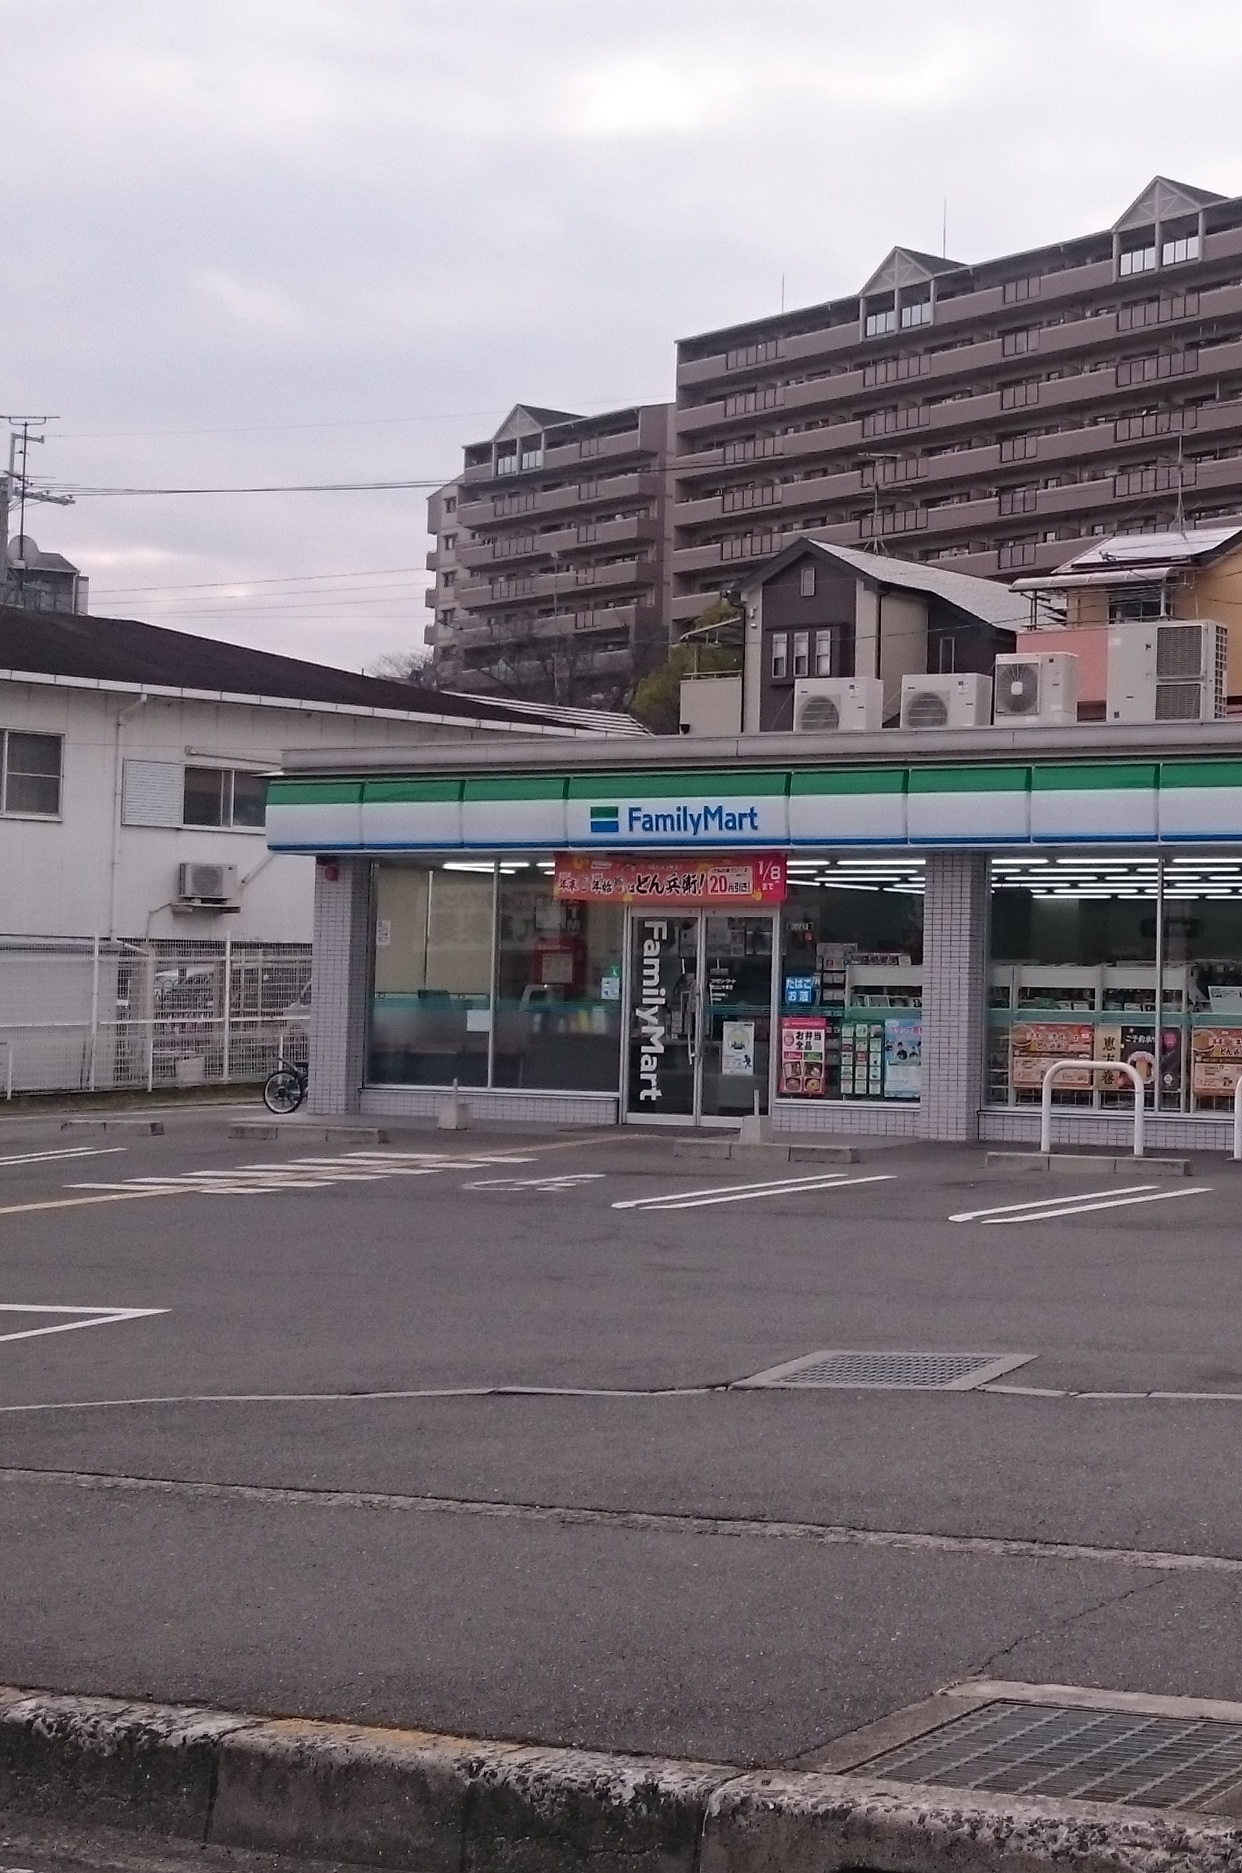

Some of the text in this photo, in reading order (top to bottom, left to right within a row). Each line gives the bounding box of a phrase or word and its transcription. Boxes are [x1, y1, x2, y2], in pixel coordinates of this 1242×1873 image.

[628, 806, 758, 835] FamilyMart
[636, 921, 668, 1101] FamilyMart
[796, 1031, 821, 1040] お弁当
